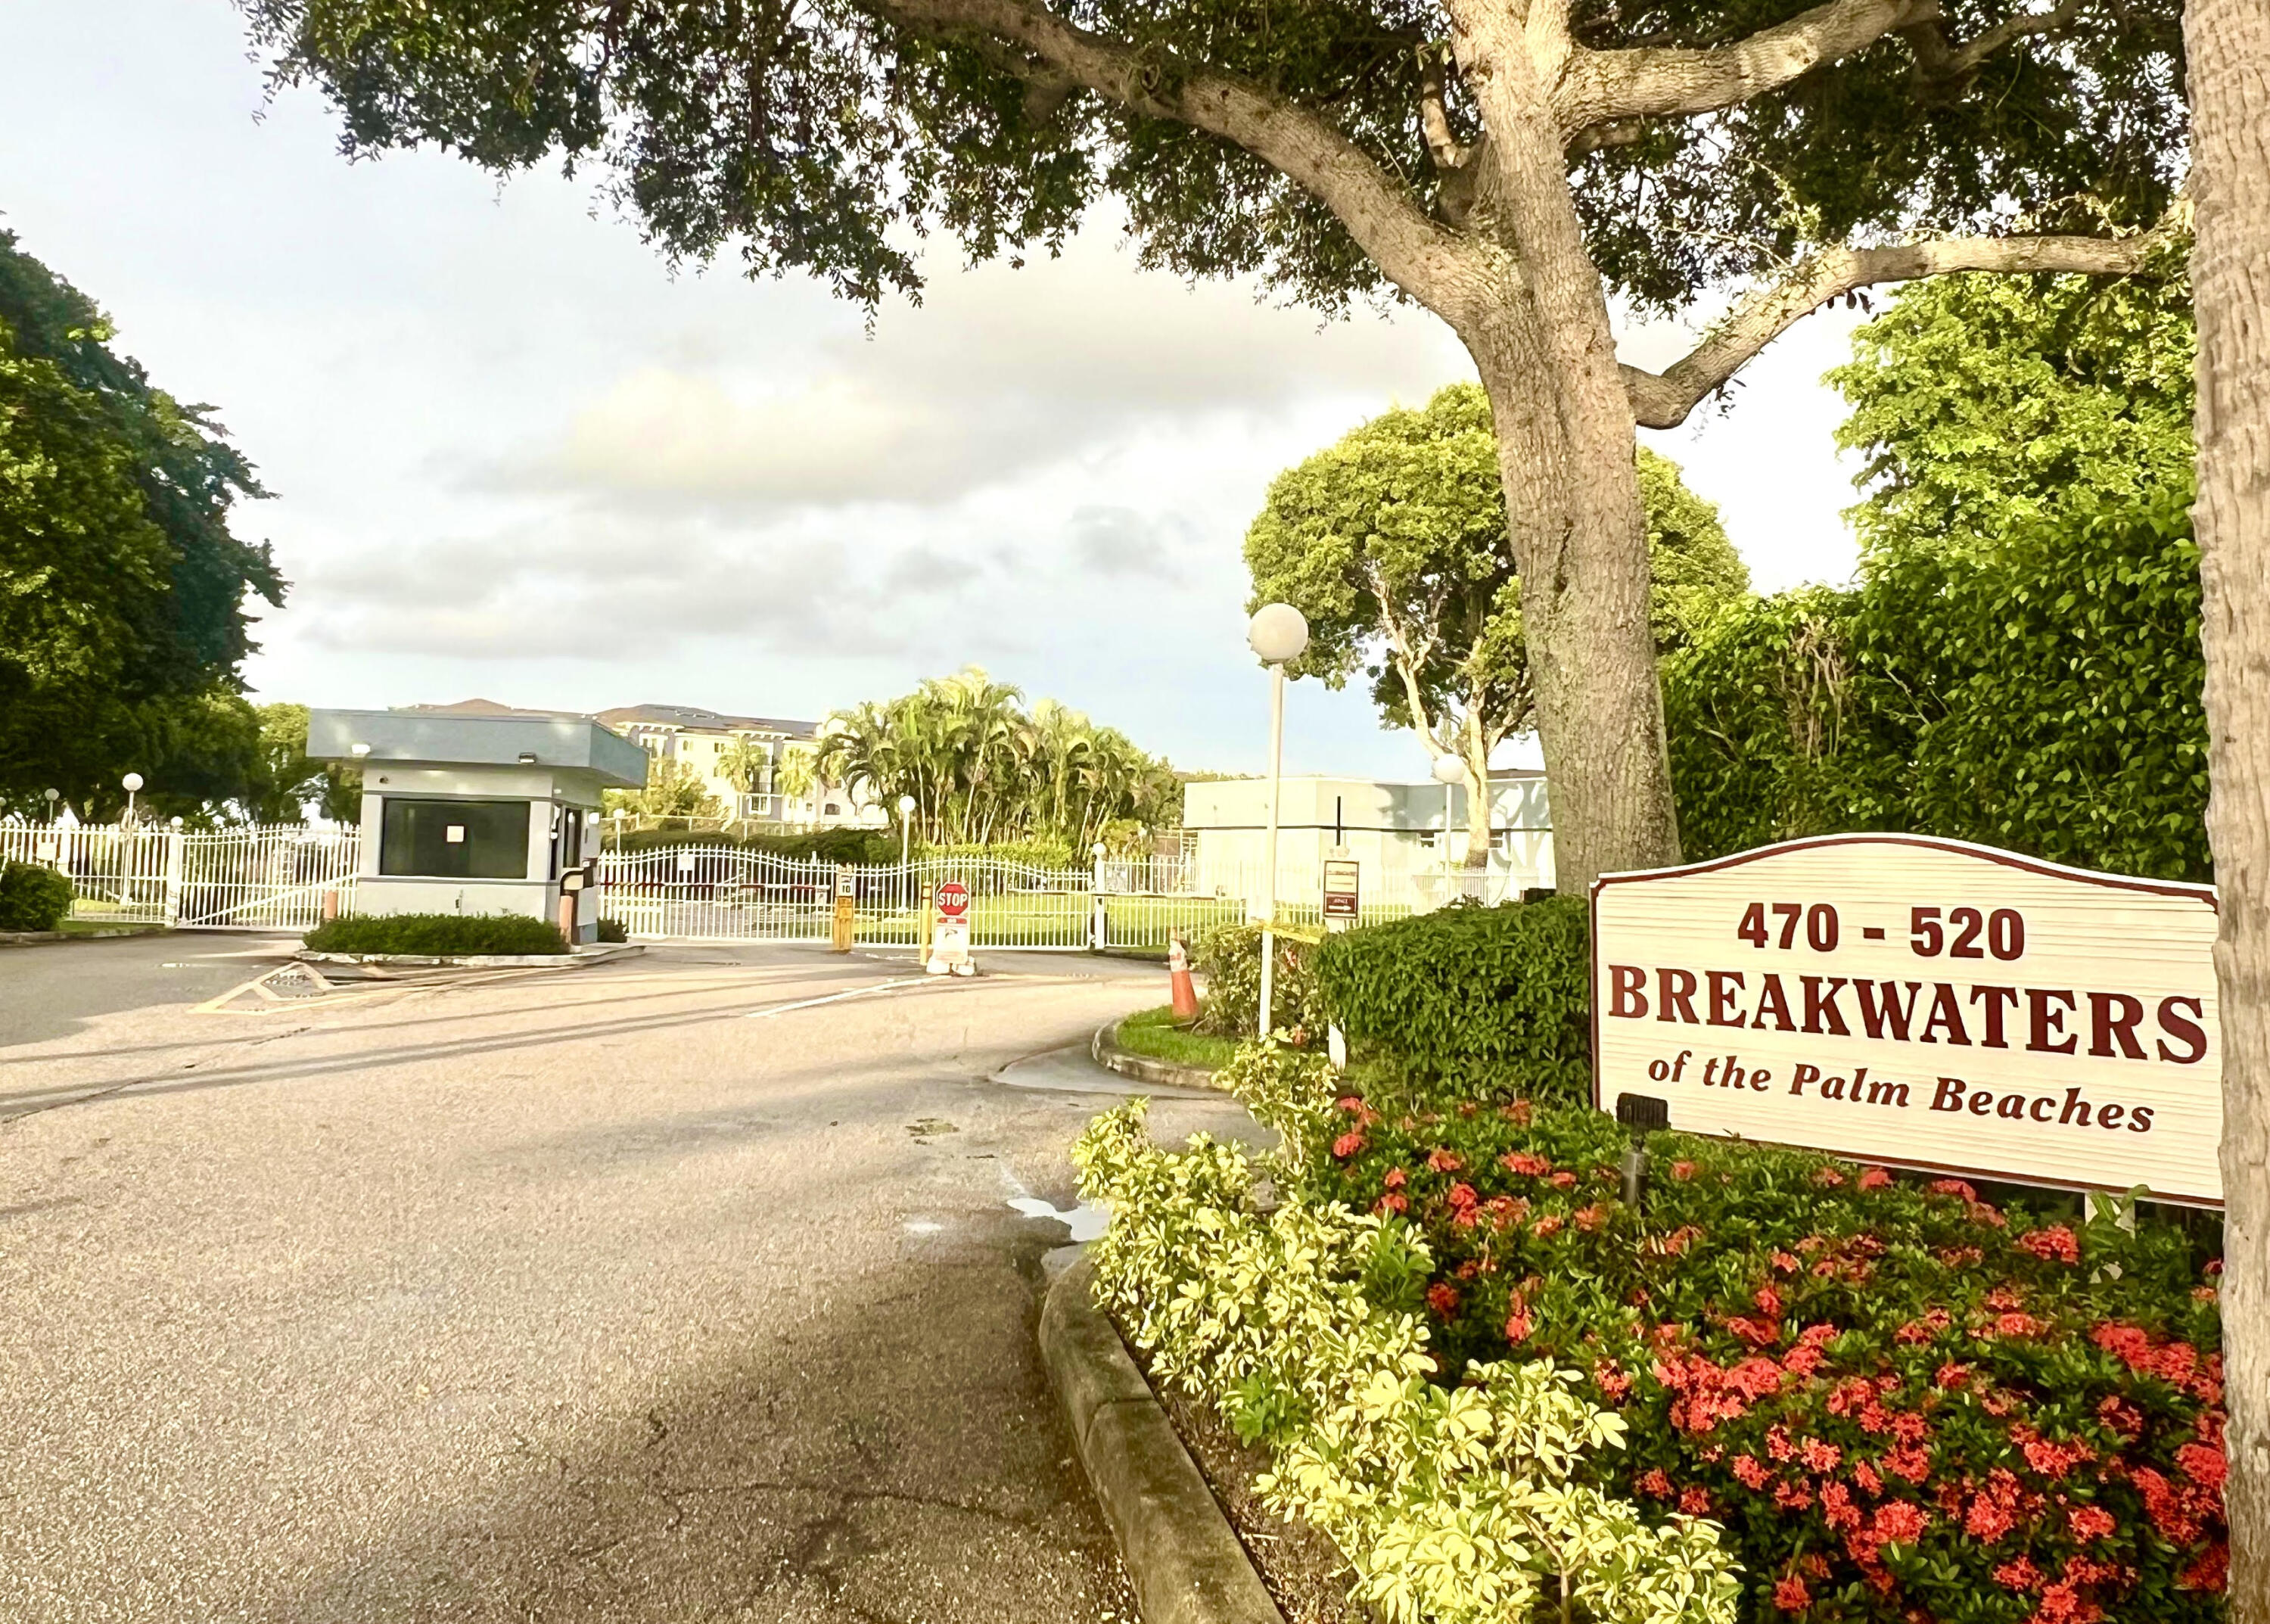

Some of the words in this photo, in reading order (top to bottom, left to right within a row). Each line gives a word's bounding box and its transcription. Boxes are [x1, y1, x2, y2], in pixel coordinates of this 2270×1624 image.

[938, 892, 968, 907] STOP
[1737, 901, 1840, 954] 470
[1861, 926, 1886, 941] -
[1909, 906, 2026, 962] 520
[1607, 963, 2209, 1066] BREAKWATERS
[1647, 1049, 1693, 1084] of
[1702, 1054, 1772, 1093] the
[1787, 1062, 1911, 1108] Palm
[1929, 1077, 2155, 1134] Beaches
